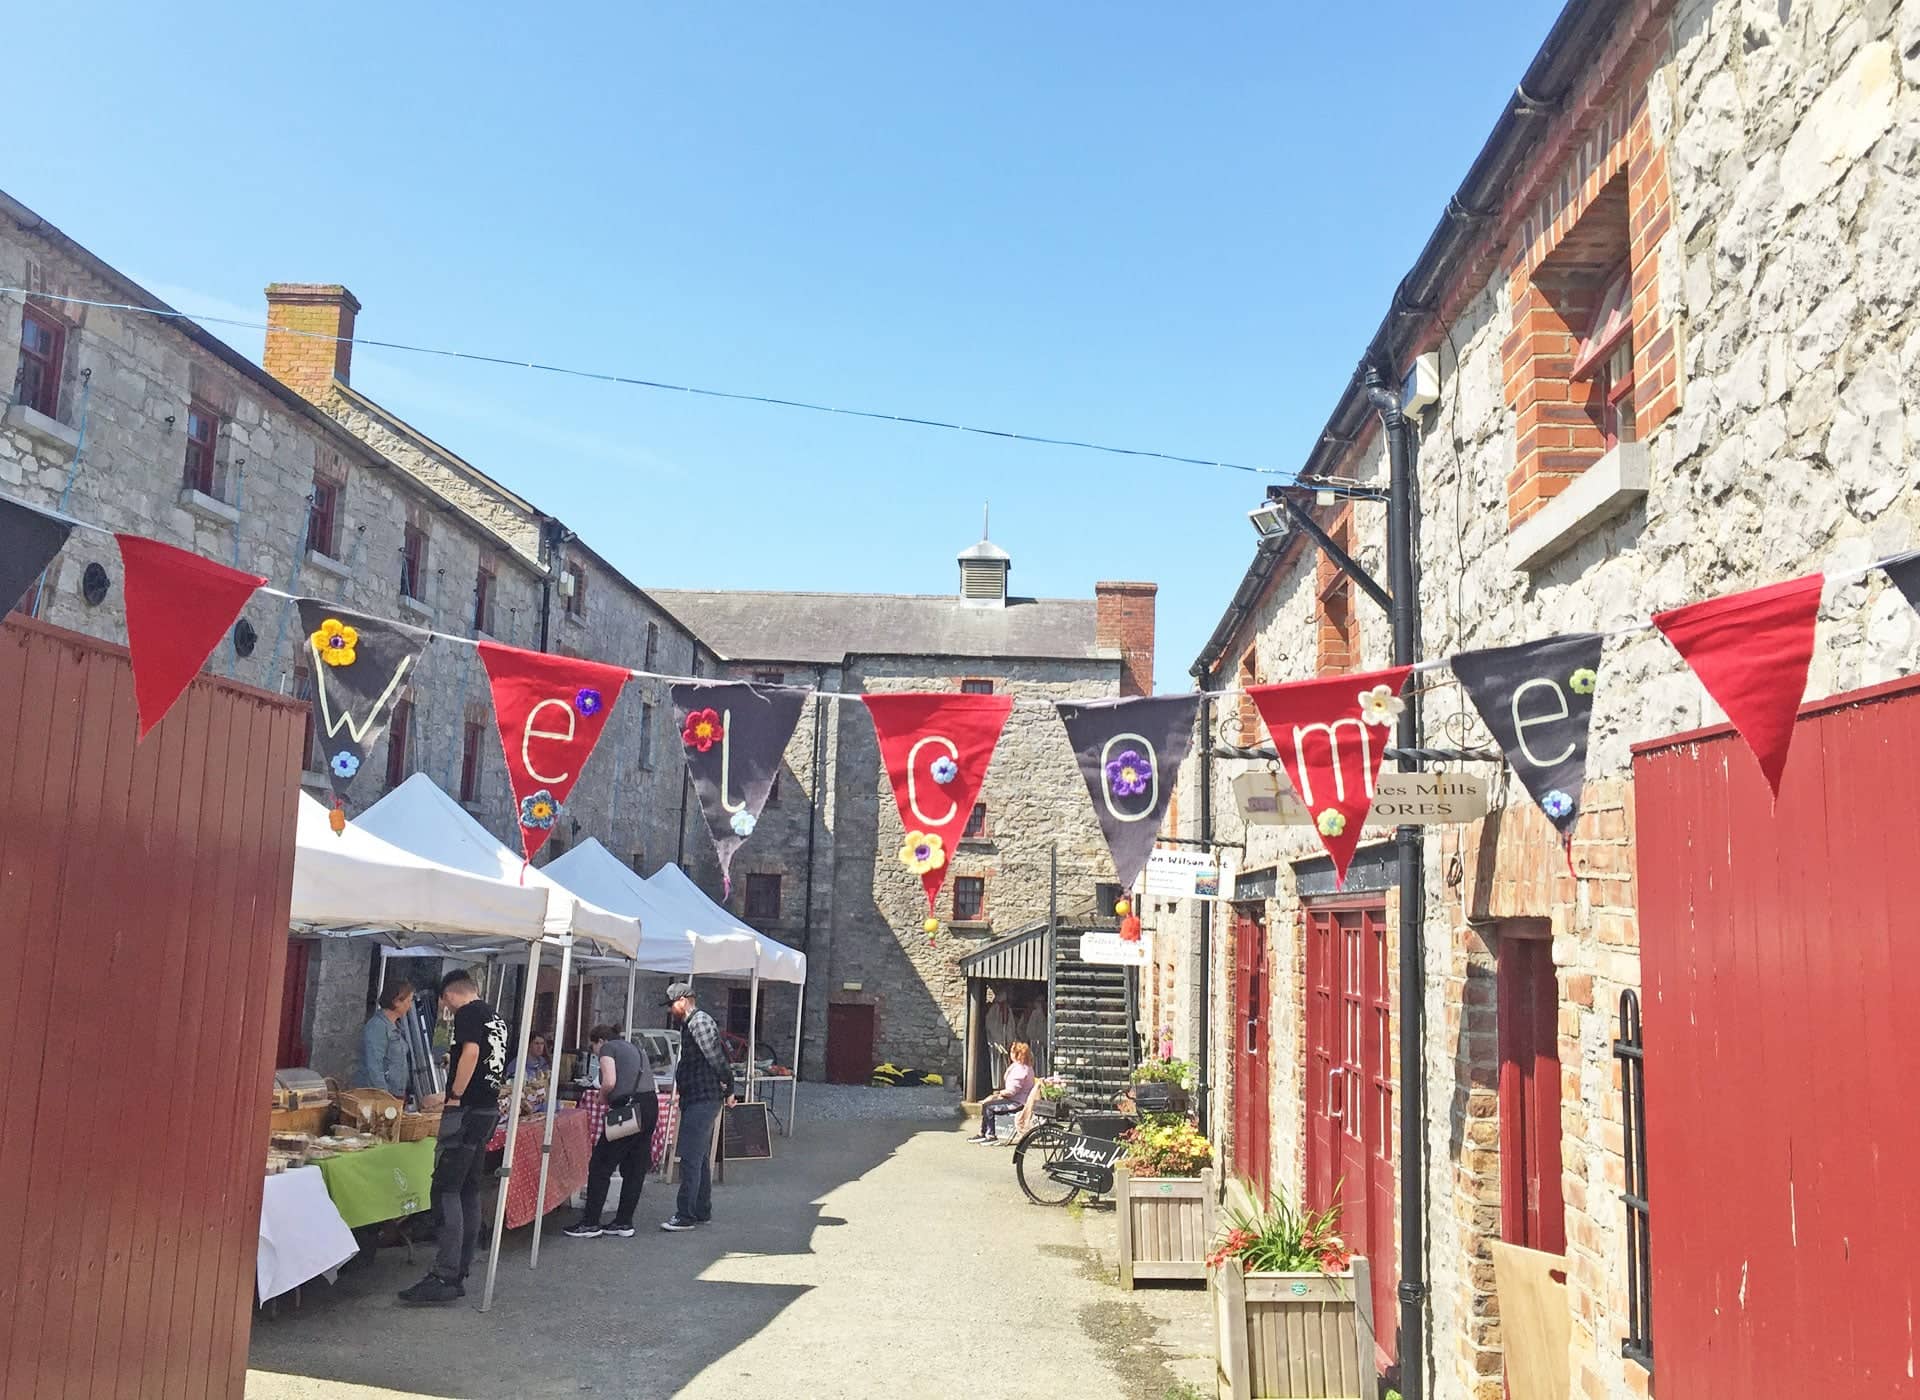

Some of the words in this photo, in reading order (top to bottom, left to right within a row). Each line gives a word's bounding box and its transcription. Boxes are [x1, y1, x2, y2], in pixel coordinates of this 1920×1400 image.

[1416, 783, 1477, 796] Mills
[1372, 803, 1453, 816] ORES
[1168, 856, 1204, 867] Wilson
